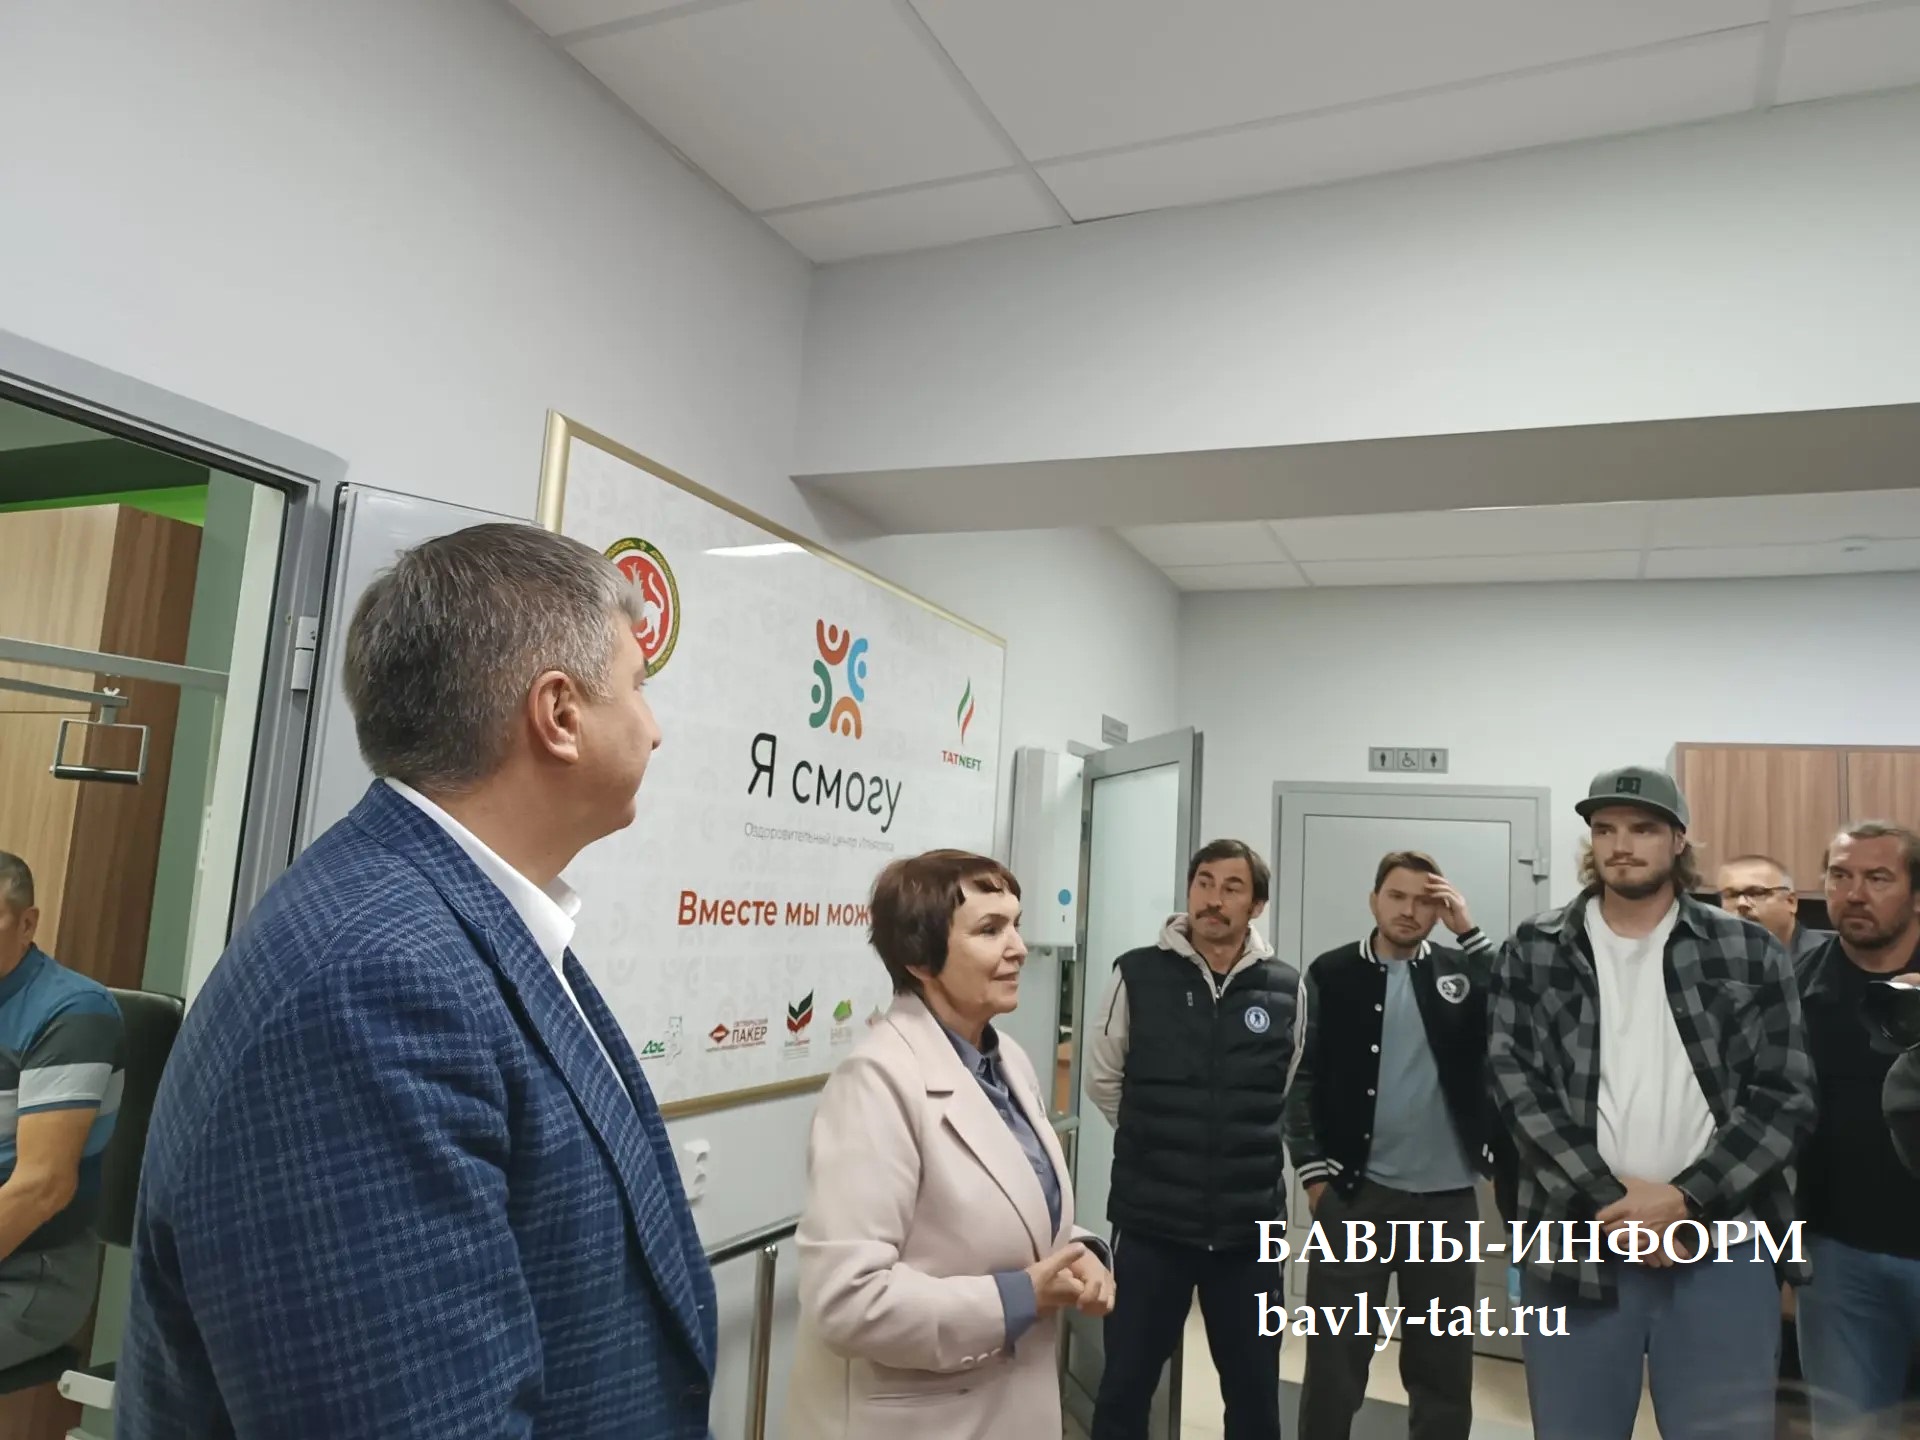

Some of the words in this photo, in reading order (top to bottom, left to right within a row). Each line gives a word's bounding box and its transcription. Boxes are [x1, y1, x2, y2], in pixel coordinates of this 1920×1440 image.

[942, 750, 982, 772] TATNEFT
[747, 732, 777, 798] Я
[792, 760, 902, 834] смогу
[678, 890, 778, 926] Вместе
[785, 901, 820, 926] мы
[826, 902, 872, 926] мож
[732, 1026, 768, 1043] ПАКЕР
